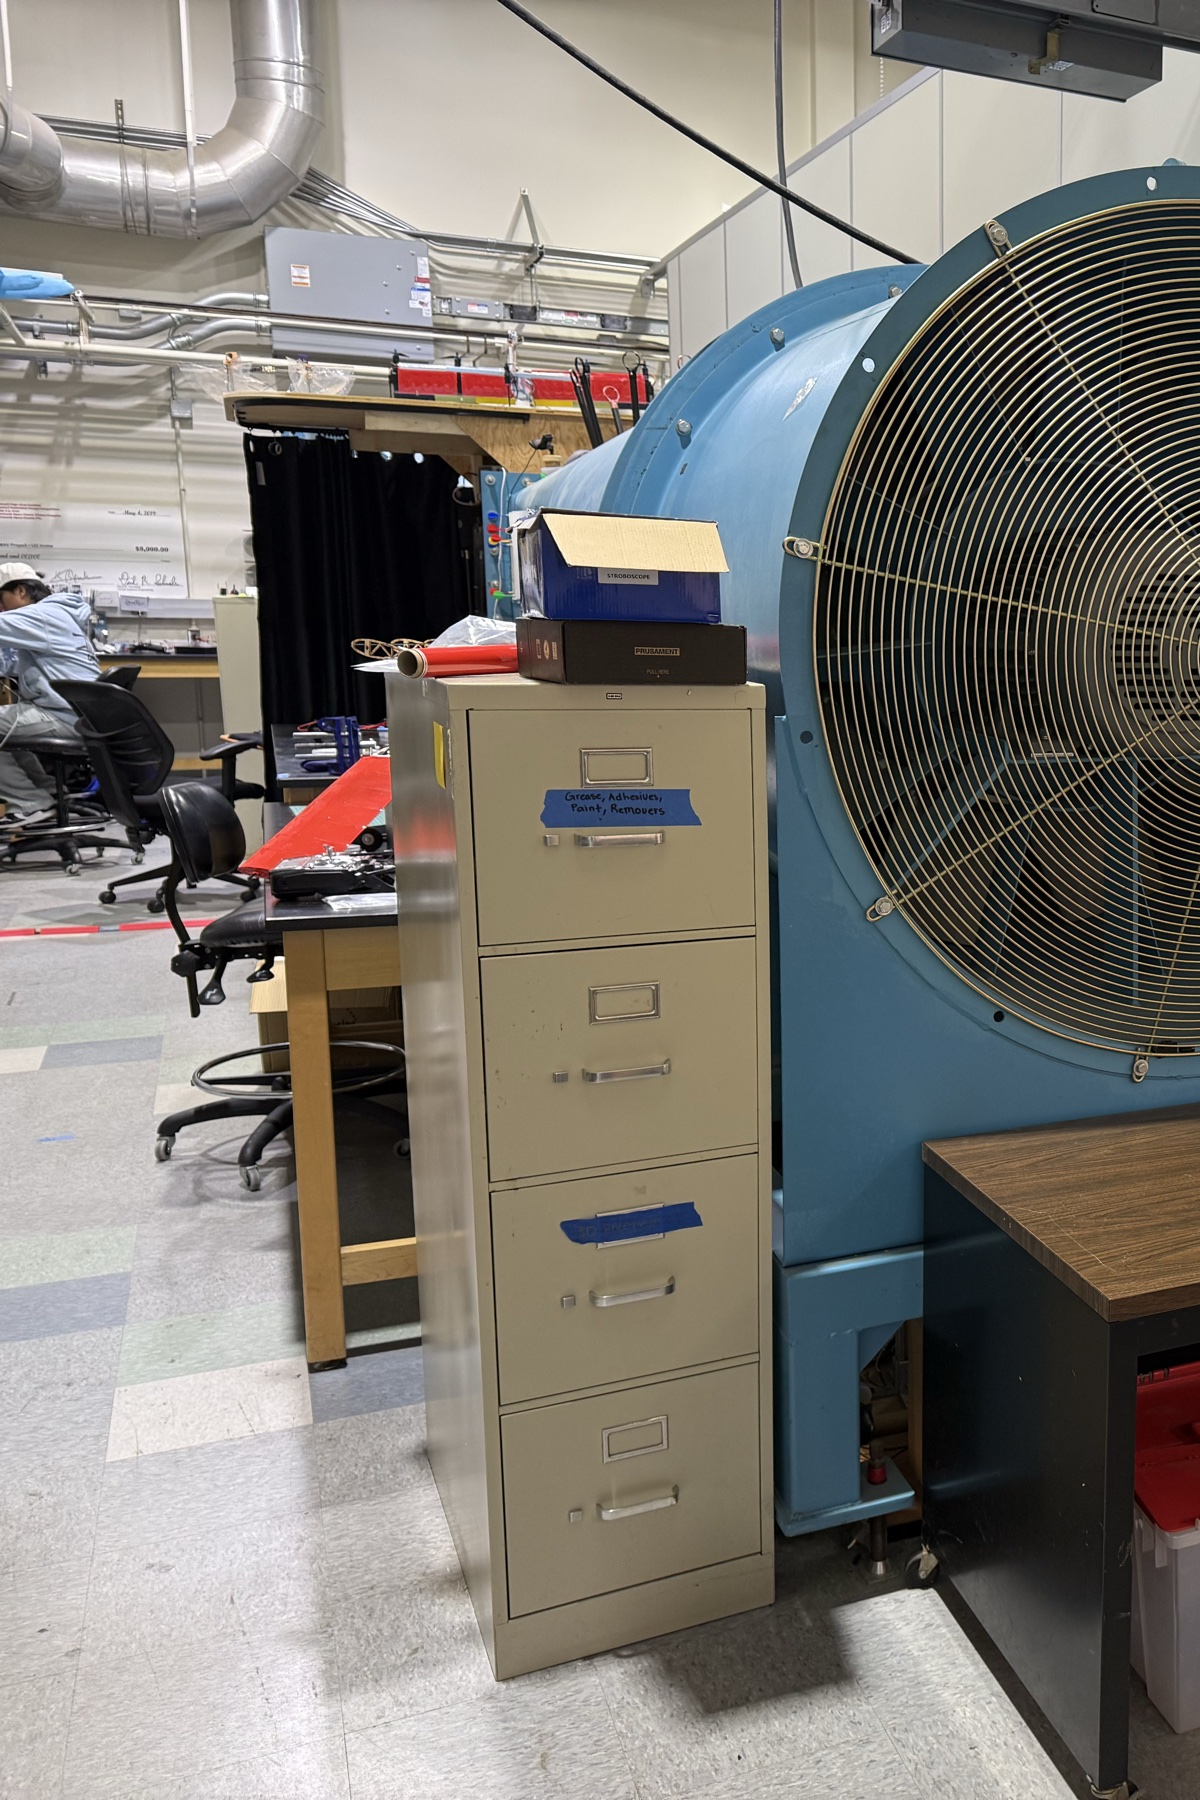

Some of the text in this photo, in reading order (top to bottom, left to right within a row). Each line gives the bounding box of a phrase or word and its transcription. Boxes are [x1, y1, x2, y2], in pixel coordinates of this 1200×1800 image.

[565, 792, 663, 803] Grease, Adhesives,
[571, 804, 665, 815] Paint, Removers
